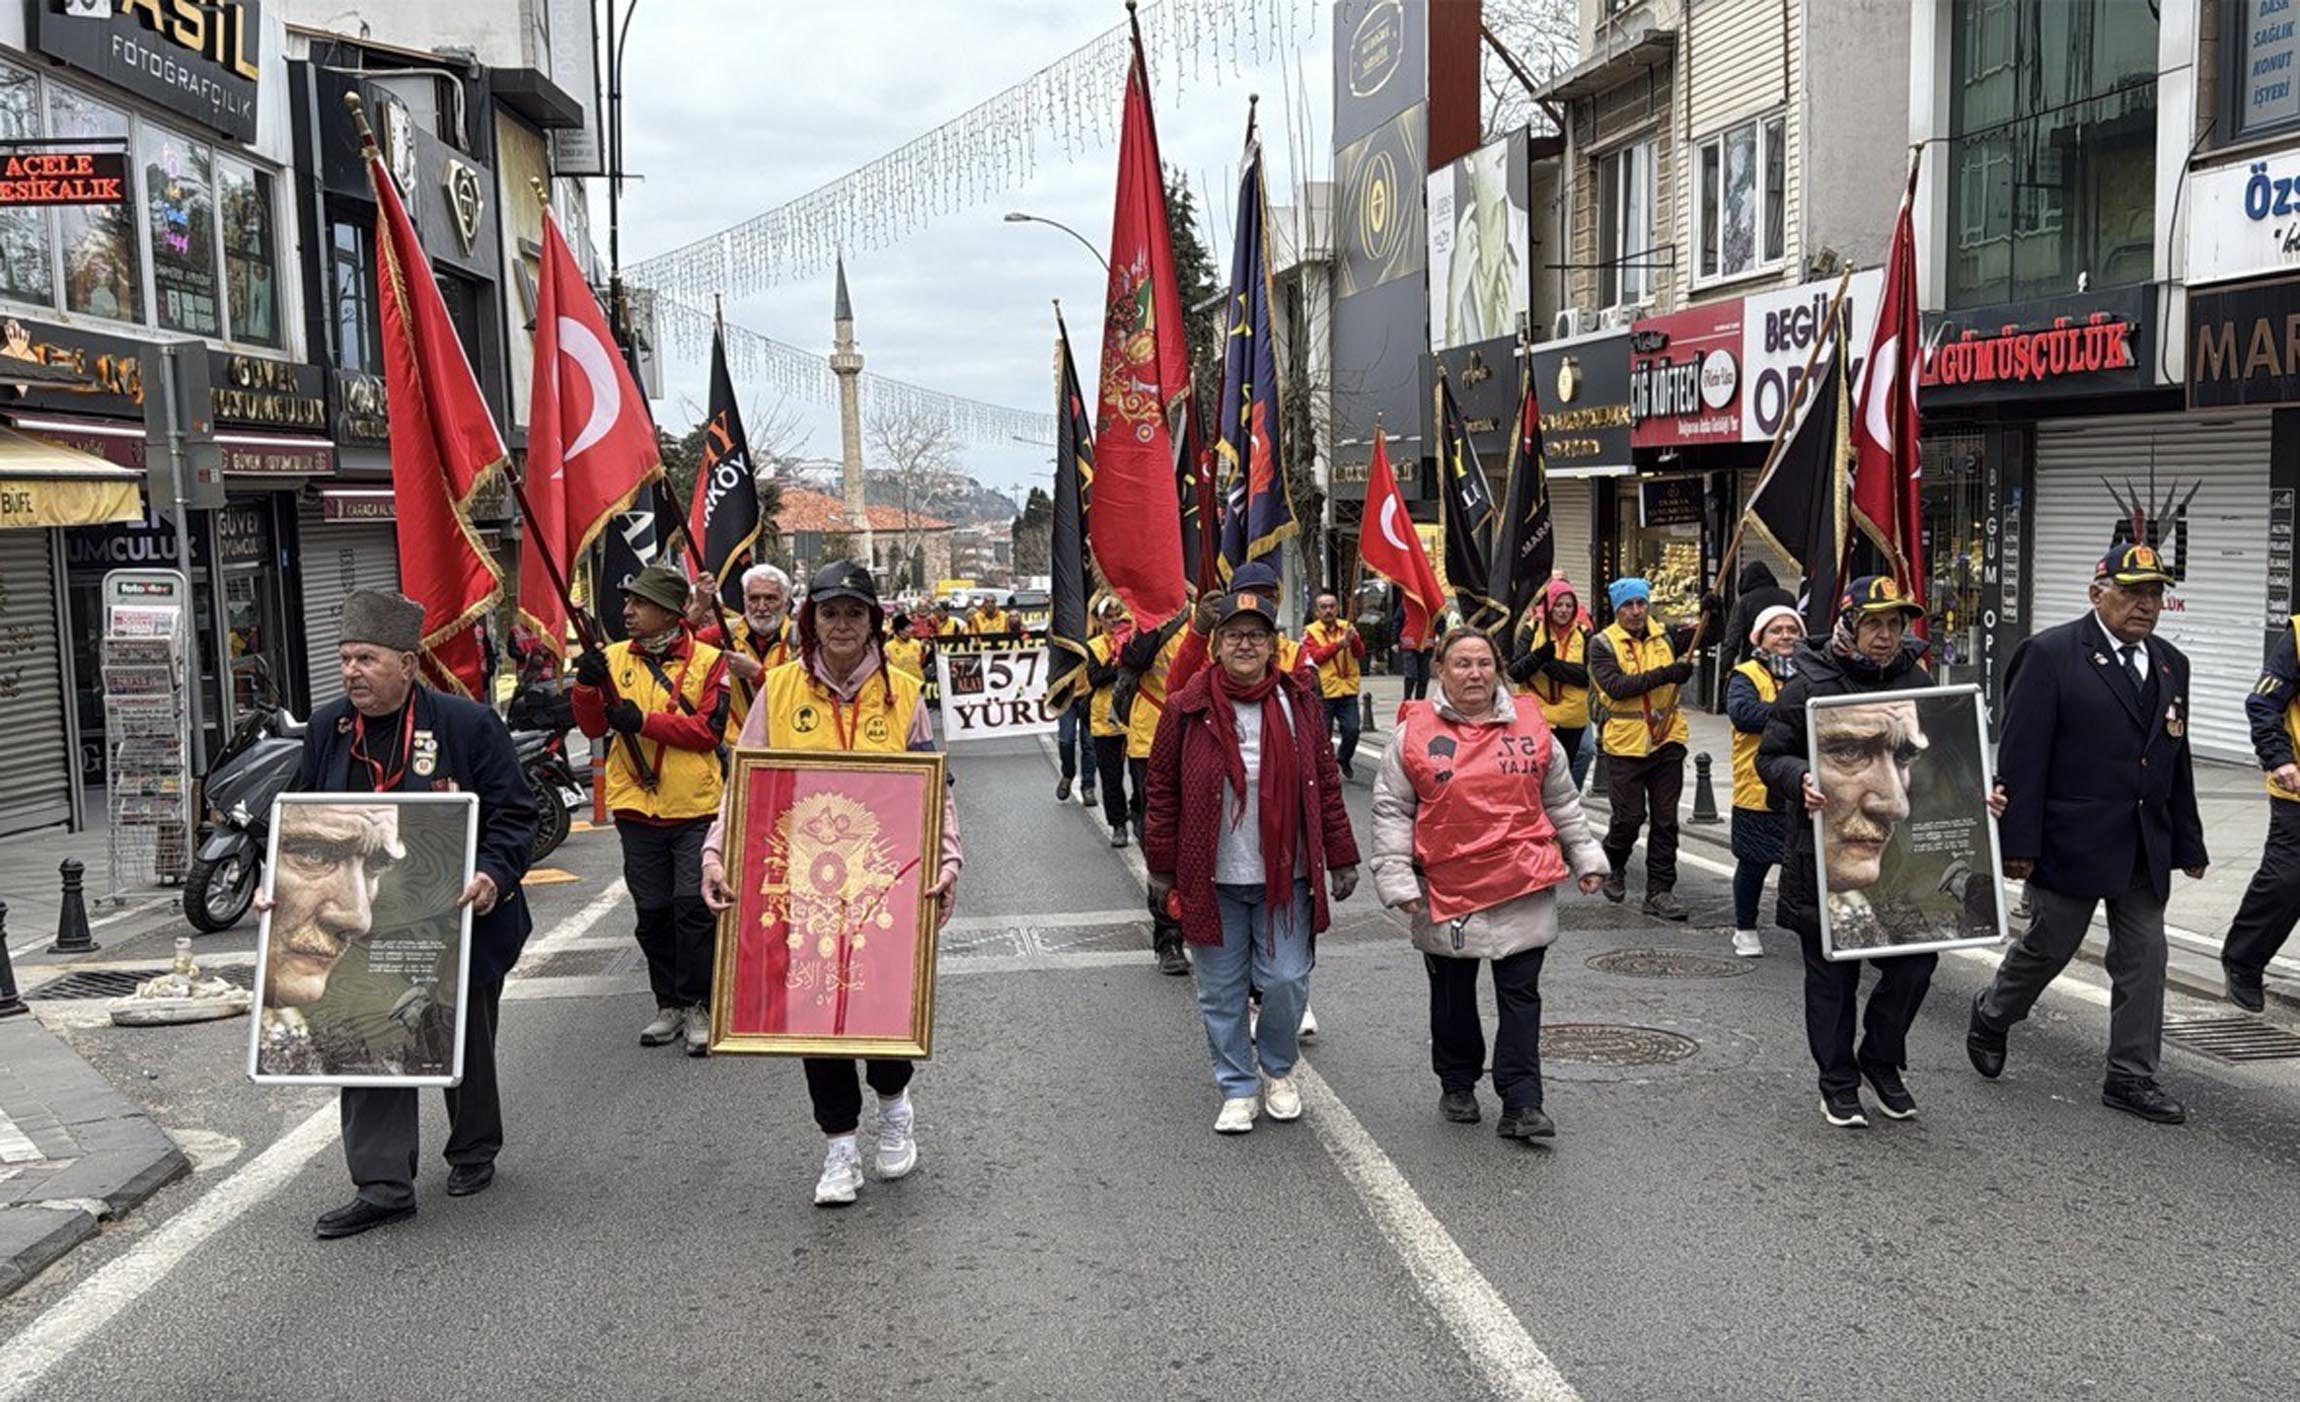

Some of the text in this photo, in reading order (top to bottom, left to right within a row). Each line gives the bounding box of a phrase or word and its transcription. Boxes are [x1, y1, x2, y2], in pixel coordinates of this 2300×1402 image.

[2253, 21, 2295, 48] SAĞLIK
[112, 34, 251, 119] FOTOĞRAFÇILIK
[2253, 50, 2294, 76] KONUT
[2253, 76, 2291, 109] İŞYERİ
[5, 155, 93, 176] ACELE
[0, 176, 121, 200] ESİKALIK
[1940, 312, 2133, 385] GÜMÜŞÇÜLÜK
[1630, 352, 1699, 428] ÇİĞ KÖFTECİ
[2, 488, 33, 513] BÜFE
[1985, 468, 1998, 584] BEGÜM
[1984, 609, 1997, 724] OPTİK
